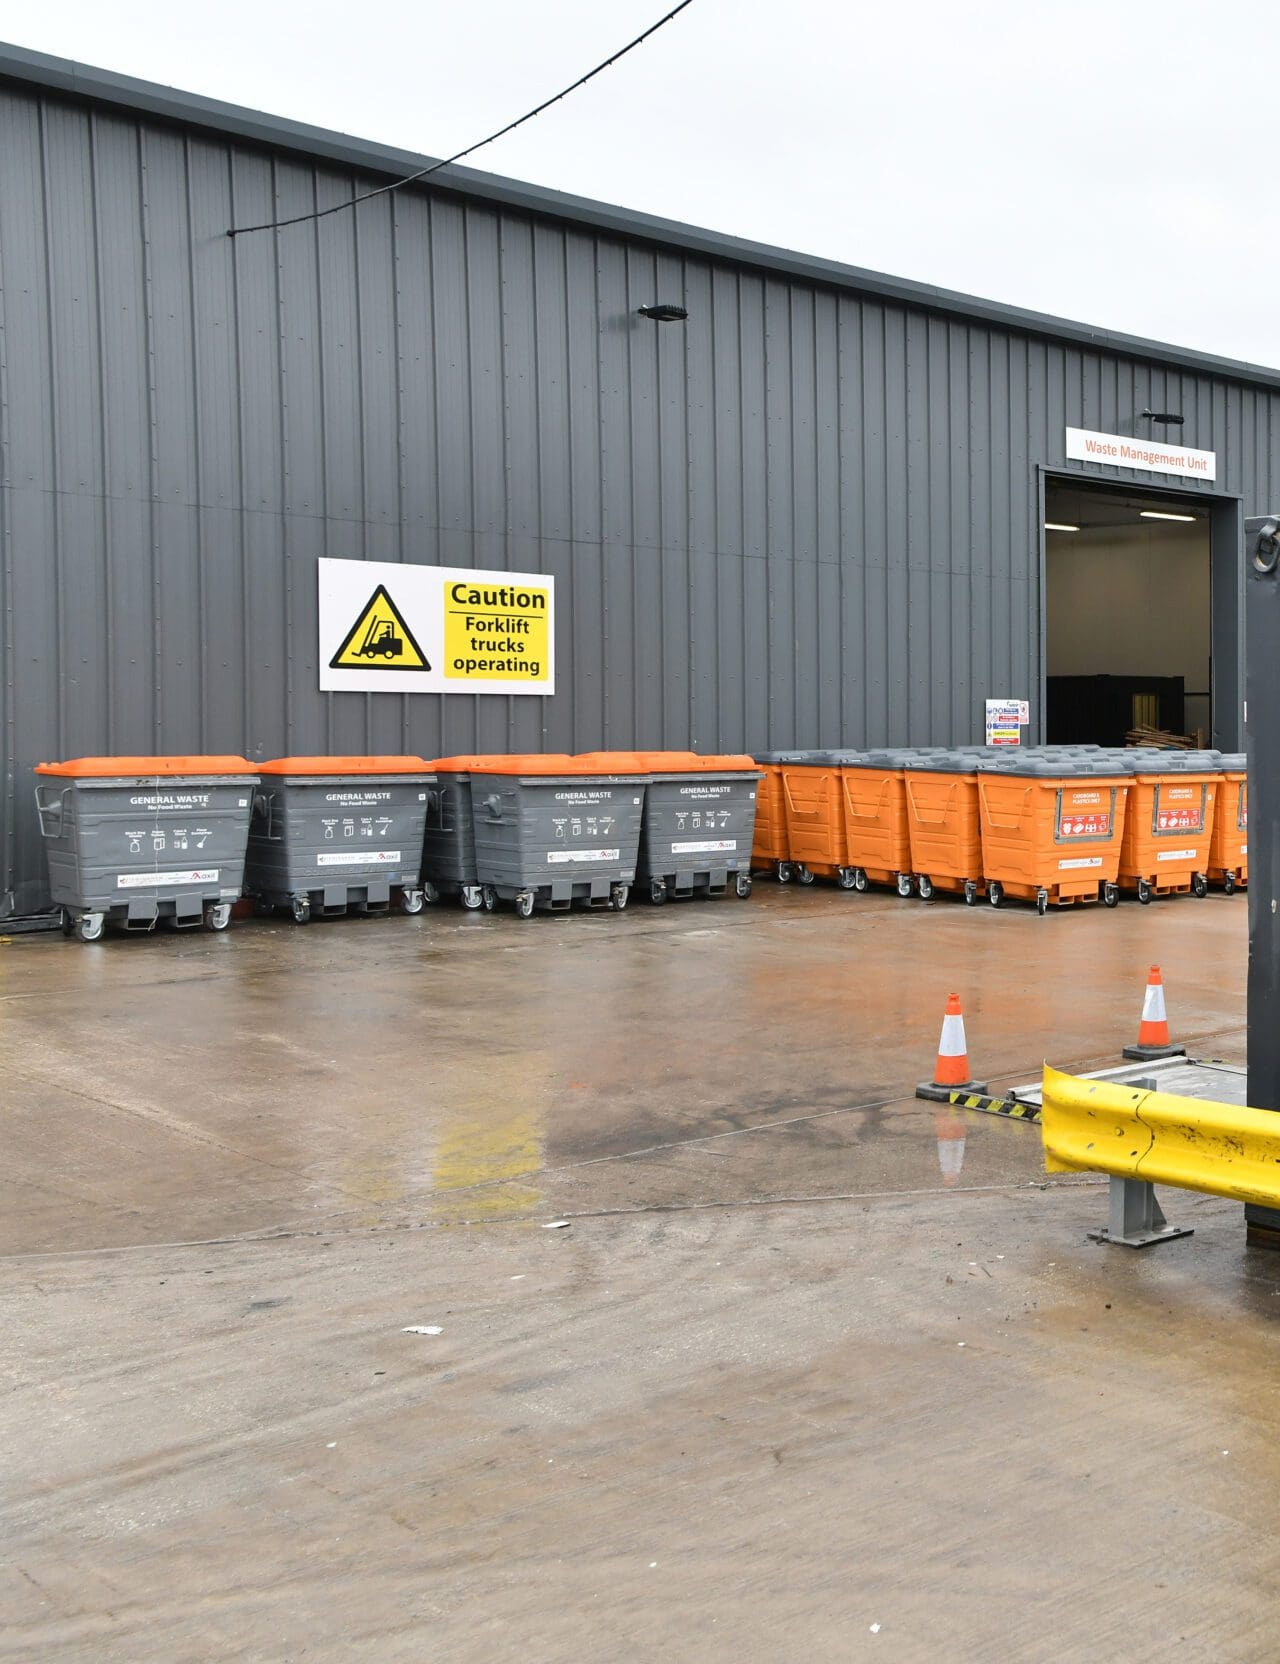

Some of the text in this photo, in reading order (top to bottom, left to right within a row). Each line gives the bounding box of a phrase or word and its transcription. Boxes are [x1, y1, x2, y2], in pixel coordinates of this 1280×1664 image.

[1085, 439, 1208, 471] Waste Management Unit
[451, 584, 545, 609] Caution
[466, 616, 530, 634] Forklift
[470, 637, 525, 653] trucks
[453, 656, 540, 676] operating
[130, 795, 209, 805] GENERAL WASTE
